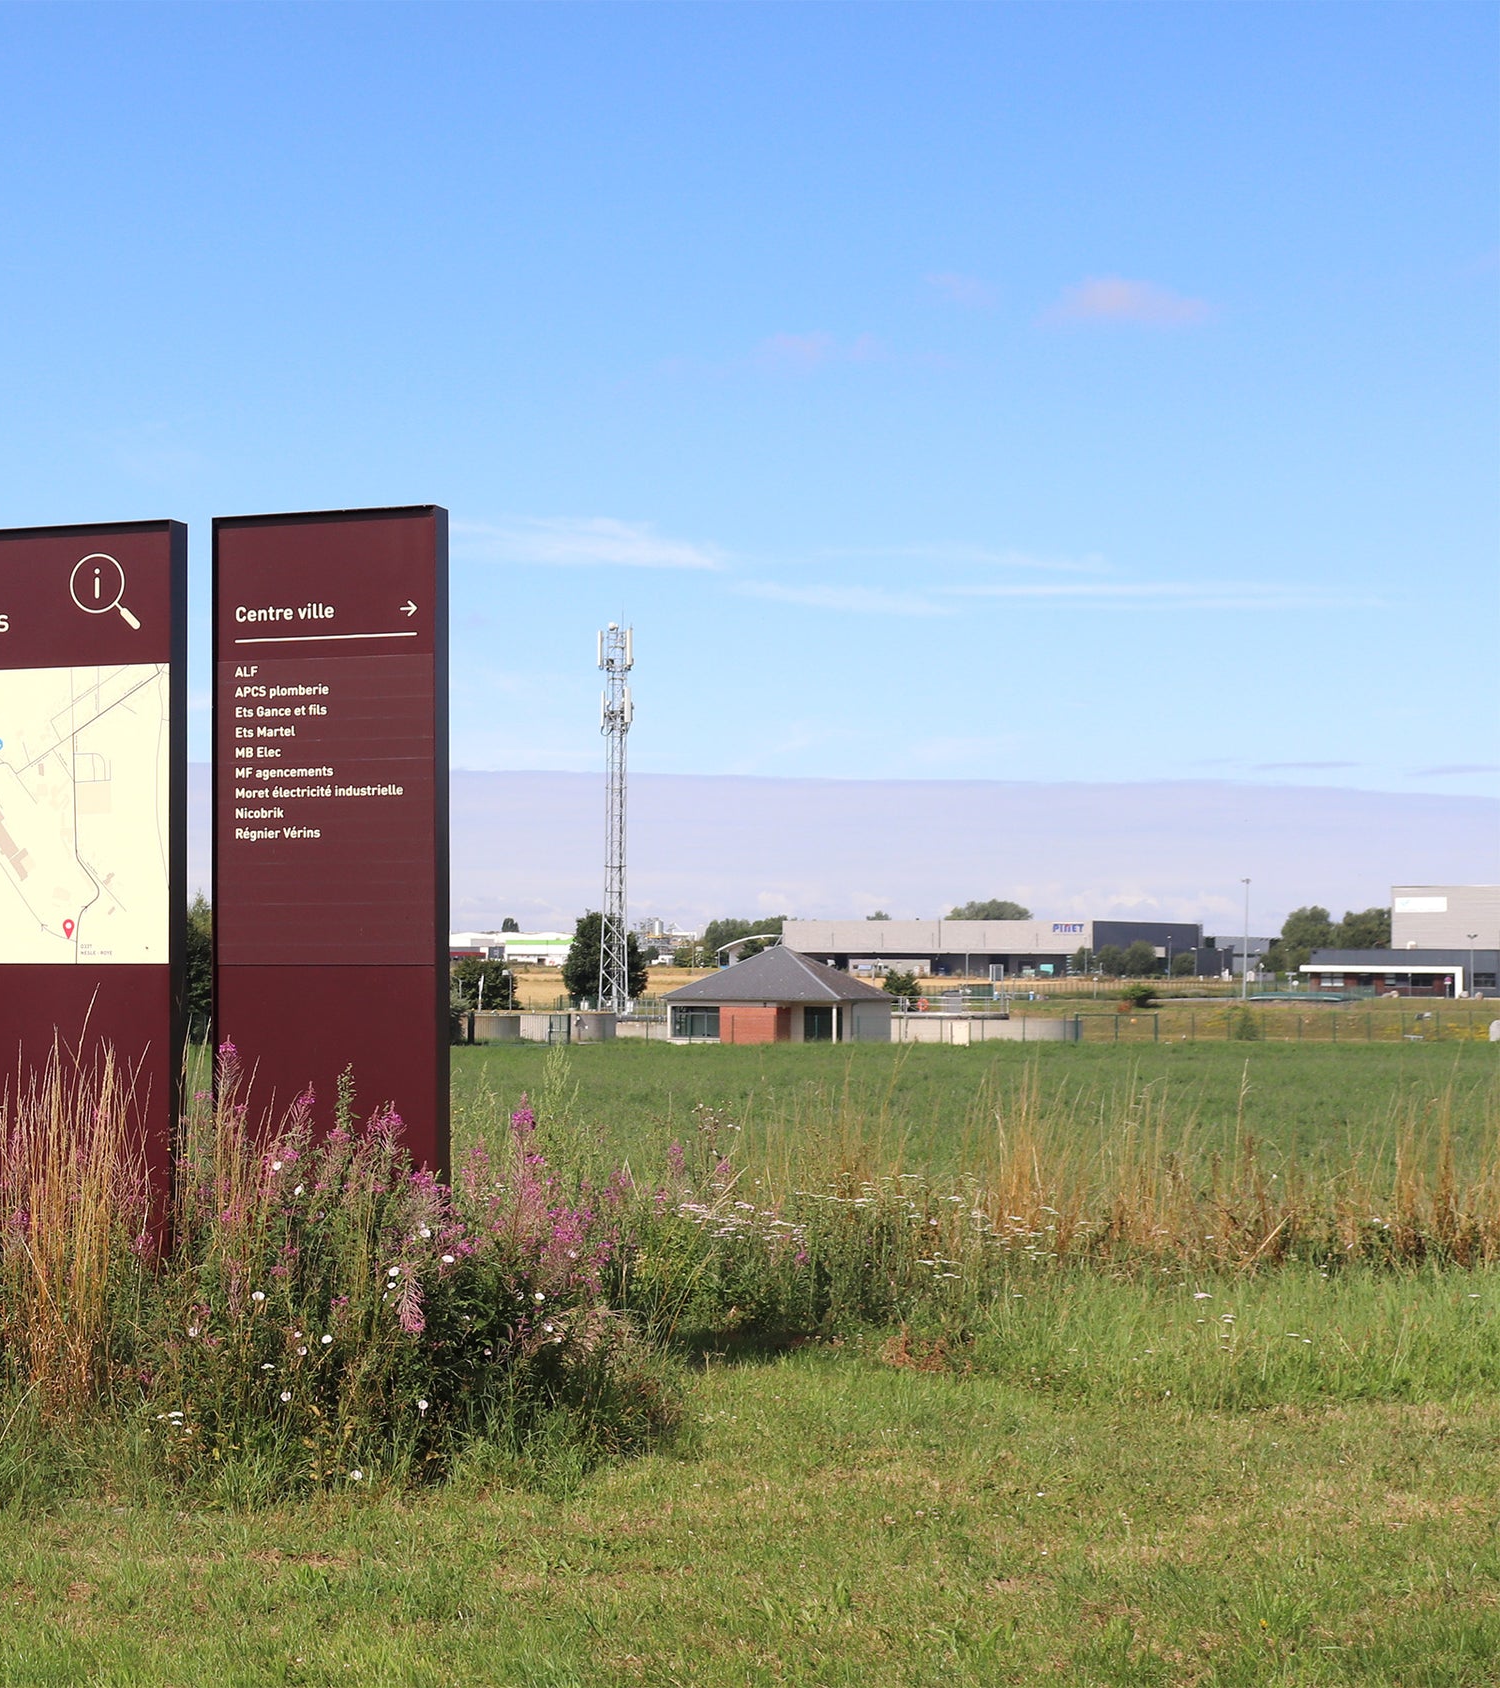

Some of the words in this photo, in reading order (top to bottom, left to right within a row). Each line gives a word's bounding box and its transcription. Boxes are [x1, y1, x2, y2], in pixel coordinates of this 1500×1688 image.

[236, 607, 293, 622] Centre
[298, 603, 334, 619] ville
[235, 666, 258, 677] ALF
[235, 686, 266, 697] APCS
[270, 684, 329, 699] plomberie
[236, 707, 253, 717] Ets
[257, 706, 291, 717] Gance
[294, 706, 306, 716] et
[309, 704, 327, 715] fils
[236, 727, 253, 738] Ets
[257, 726, 295, 737] Martel
[236, 747, 253, 758] MB
[257, 747, 281, 757] Elec
[236, 768, 253, 778] MF
[256, 766, 333, 780] agencements
[236, 788, 269, 798] Moret
[272, 785, 331, 798] électricité
[335, 784, 403, 796] industrielle
[236, 807, 283, 818] Nicobrik
[236, 827, 280, 841] Régnier
[283, 826, 320, 838] Vérins
